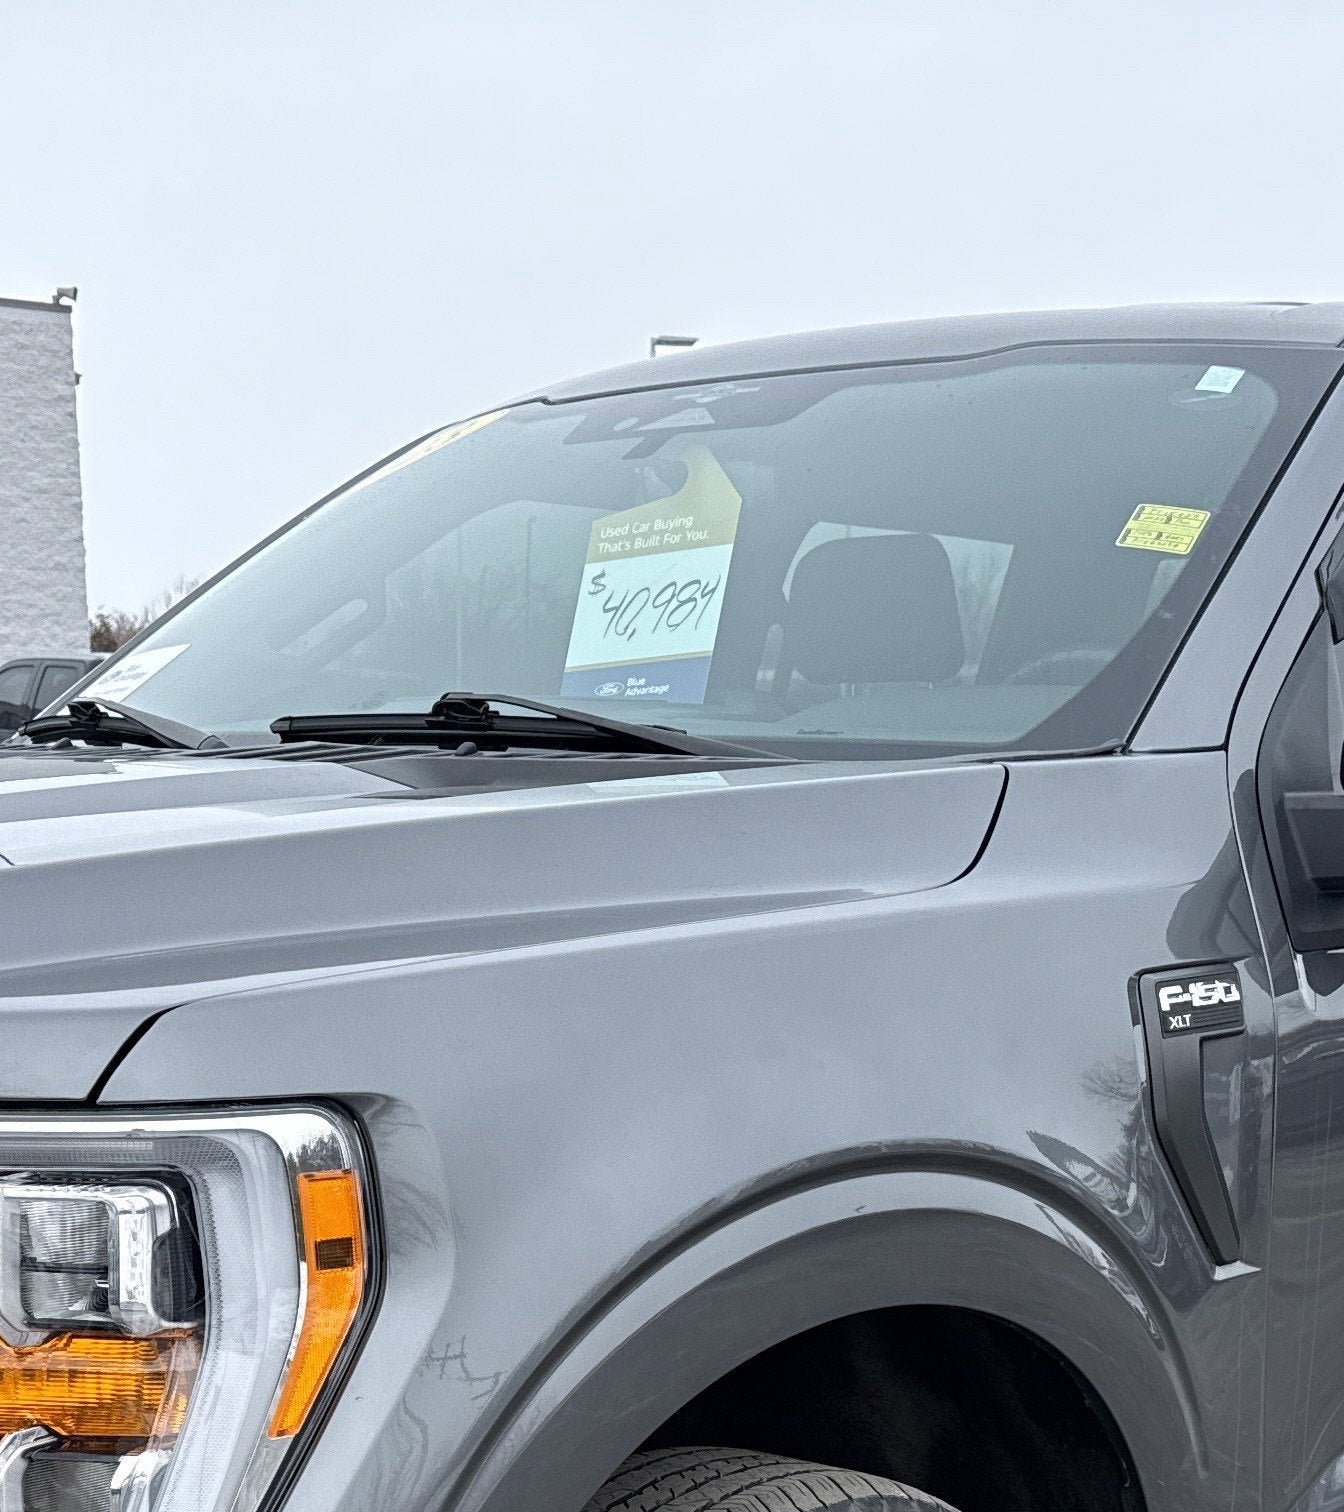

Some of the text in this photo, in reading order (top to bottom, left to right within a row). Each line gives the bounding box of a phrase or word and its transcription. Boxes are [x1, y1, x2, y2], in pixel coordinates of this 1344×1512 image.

[599, 515, 694, 540] Used Car Buying
[598, 538, 632, 555] That's
[635, 533, 661, 550] Built
[663, 532, 683, 545] For
[624, 684, 671, 698] Advantage
[627, 676, 647, 687] Blue
[1159, 980, 1241, 1012] F-150
[1168, 1014, 1193, 1030] XLT
